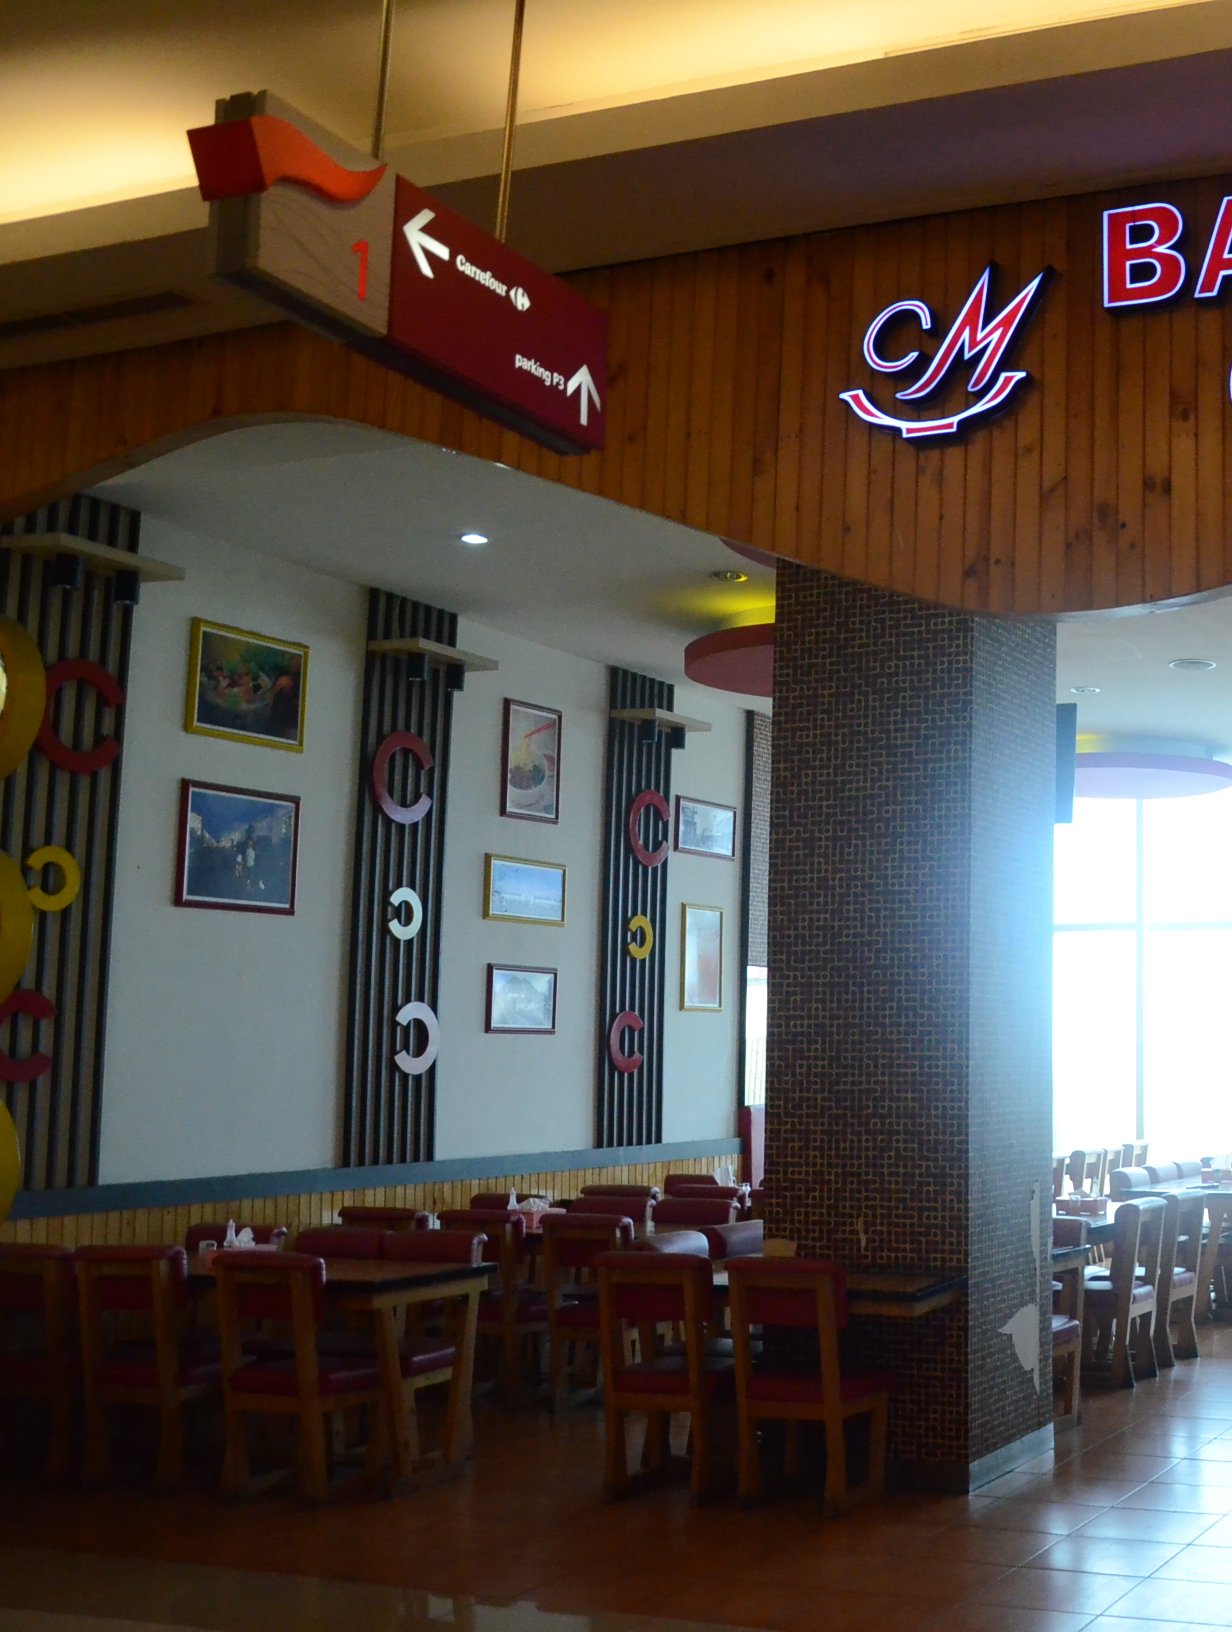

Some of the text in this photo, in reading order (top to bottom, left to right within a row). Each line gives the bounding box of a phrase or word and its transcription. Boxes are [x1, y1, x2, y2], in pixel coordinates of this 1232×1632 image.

[352, 240, 369, 301] 1
[455, 254, 508, 297] Carrefour
[515, 353, 565, 390] parking P3
